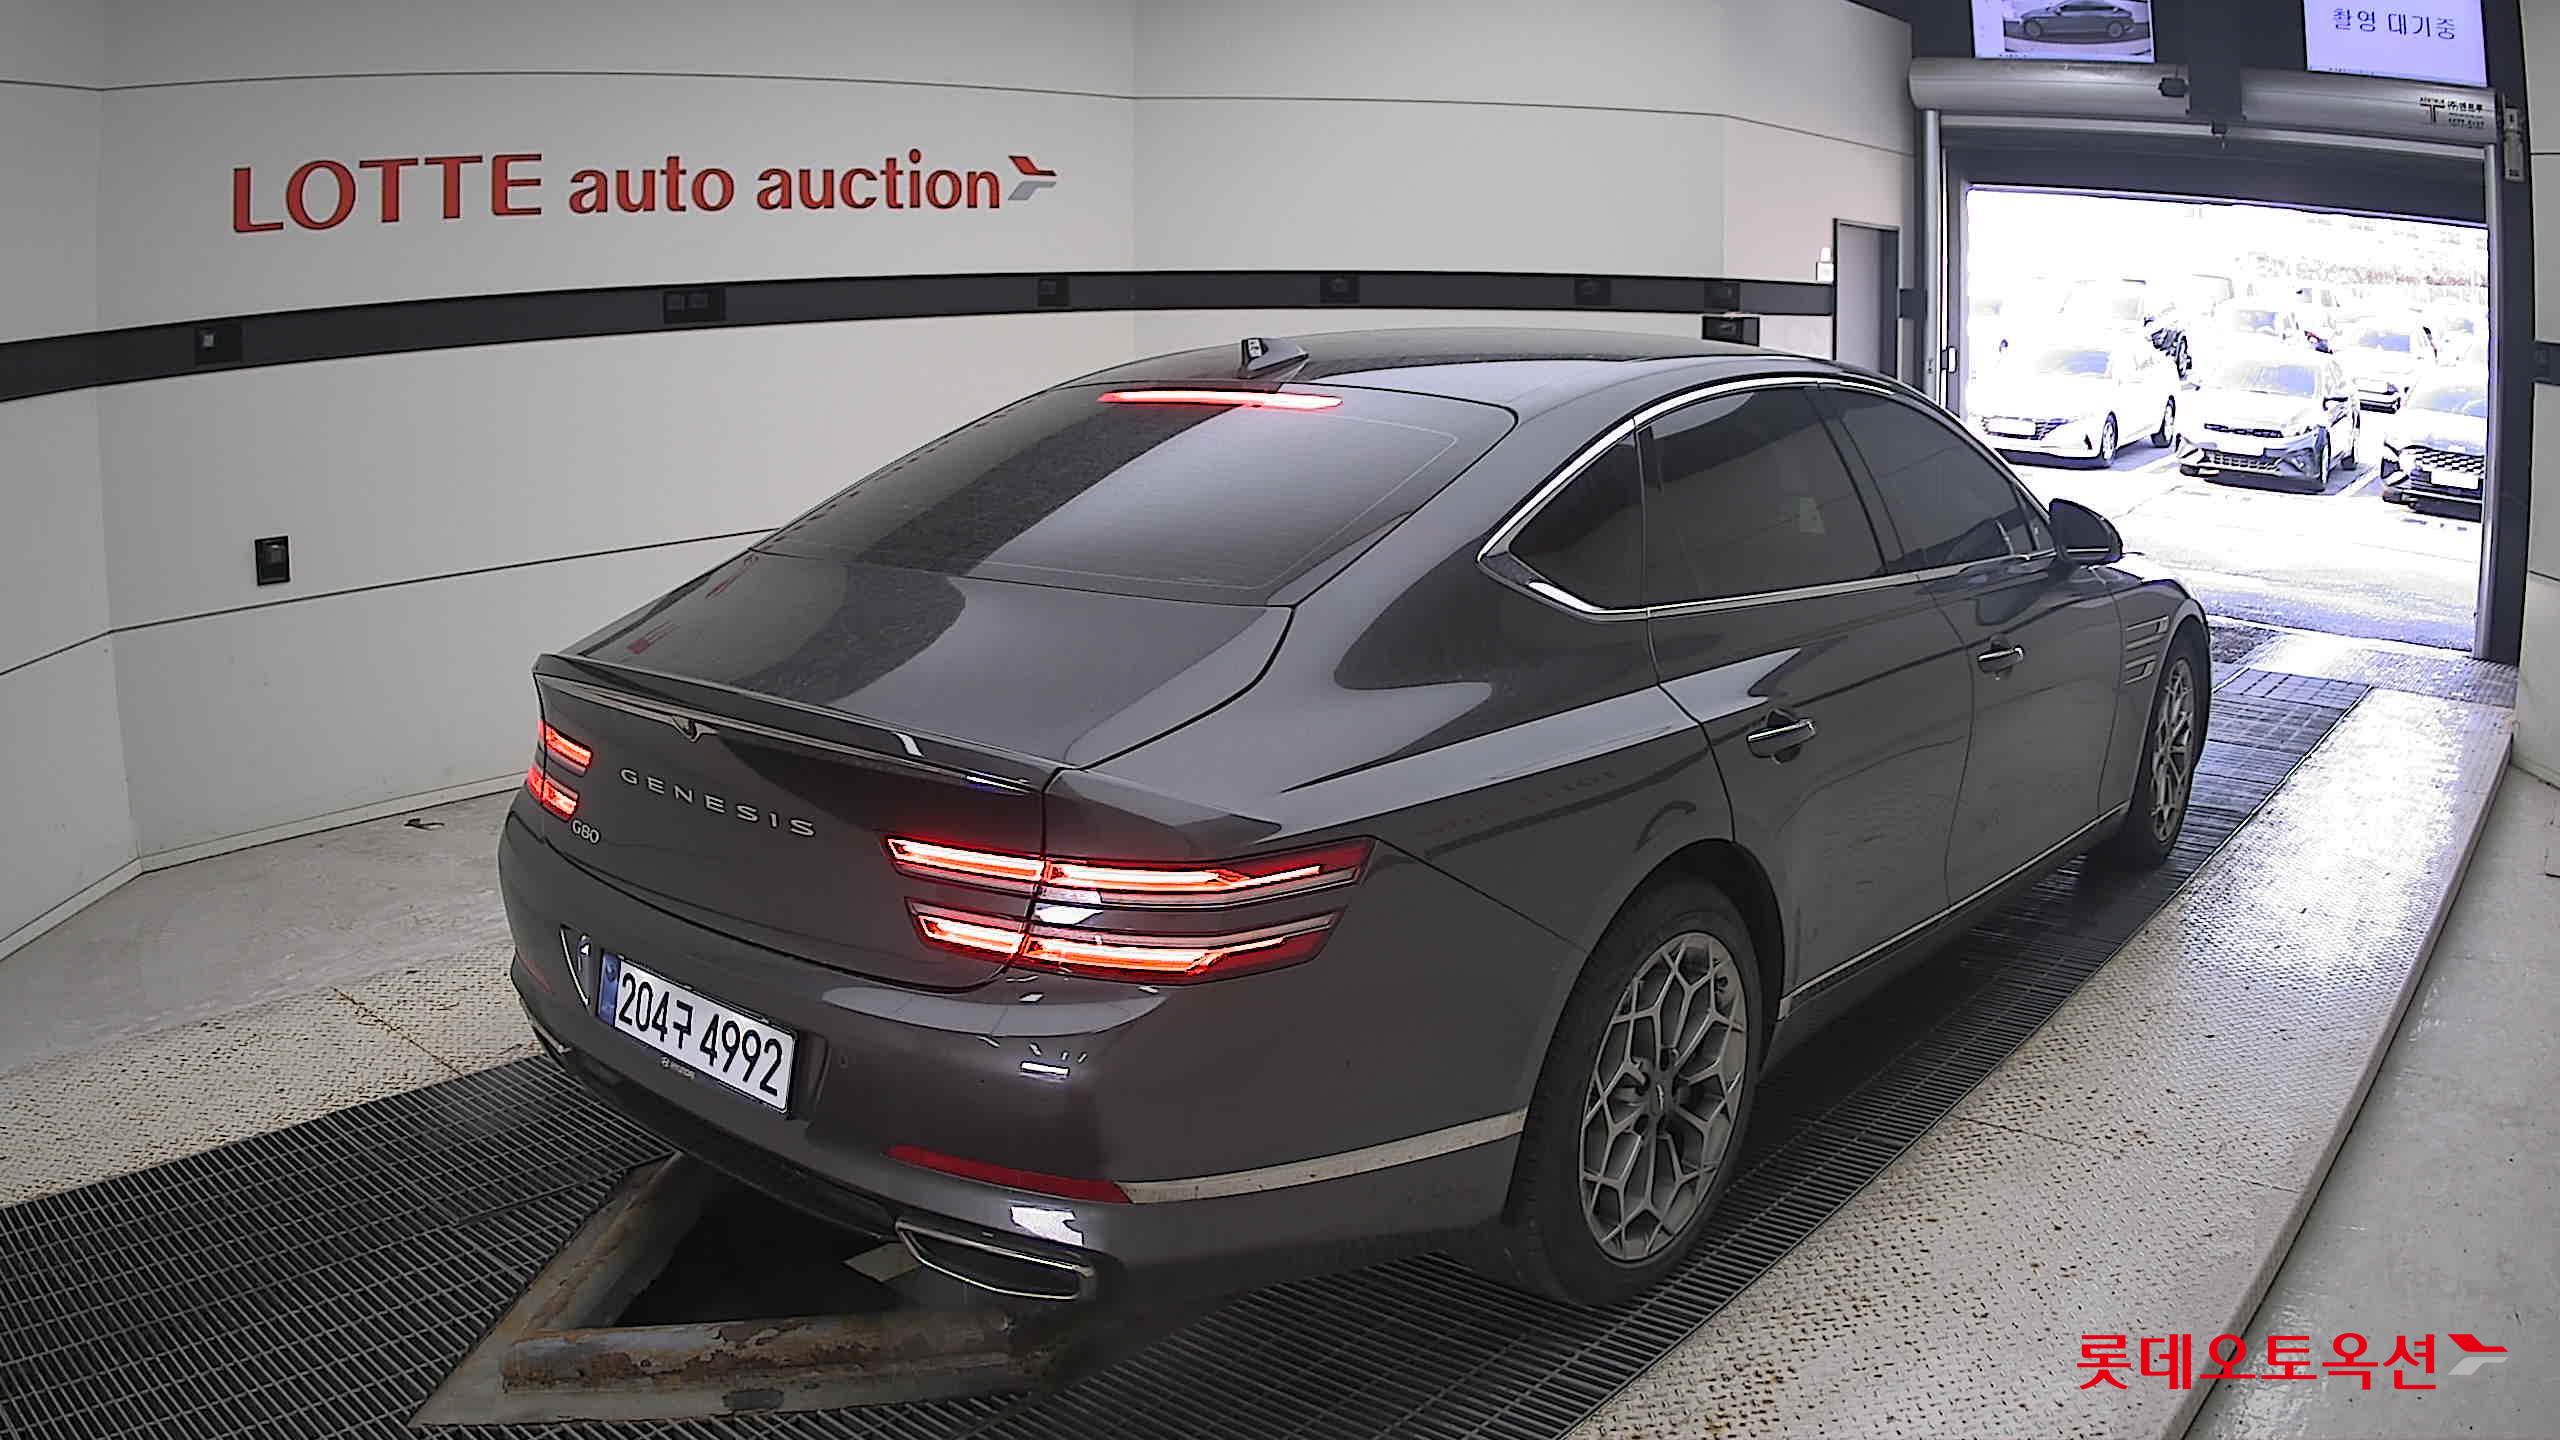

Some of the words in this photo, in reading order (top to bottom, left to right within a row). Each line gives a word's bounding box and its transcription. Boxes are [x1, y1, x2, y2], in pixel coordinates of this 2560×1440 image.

[2387, 12, 2456, 41] 대기중
[233, 153, 542, 233] LOTTE
[568, 155, 735, 214] auto
[755, 148, 1000, 209] auction
[572, 818, 600, 845] G80
[620, 768, 815, 837] GENESIS
[618, 972, 694, 1049] 204구
[700, 1013, 783, 1097] 4992
